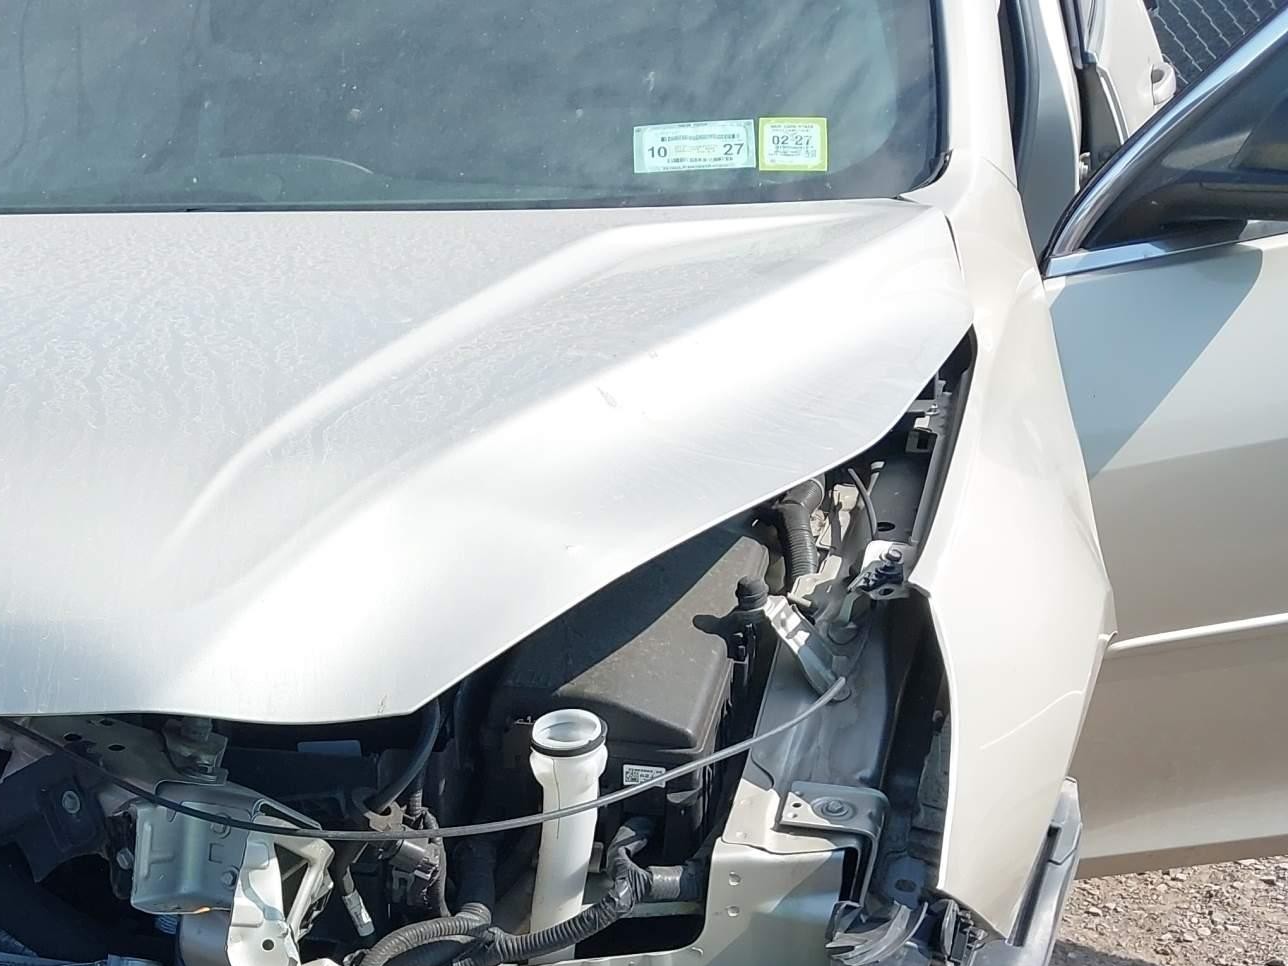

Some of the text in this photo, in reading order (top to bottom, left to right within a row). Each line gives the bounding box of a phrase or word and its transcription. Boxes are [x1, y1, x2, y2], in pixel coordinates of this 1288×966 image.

[772, 134, 813, 146] 02 27
[647, 145, 668, 158] 10
[722, 143, 744, 156] 27
